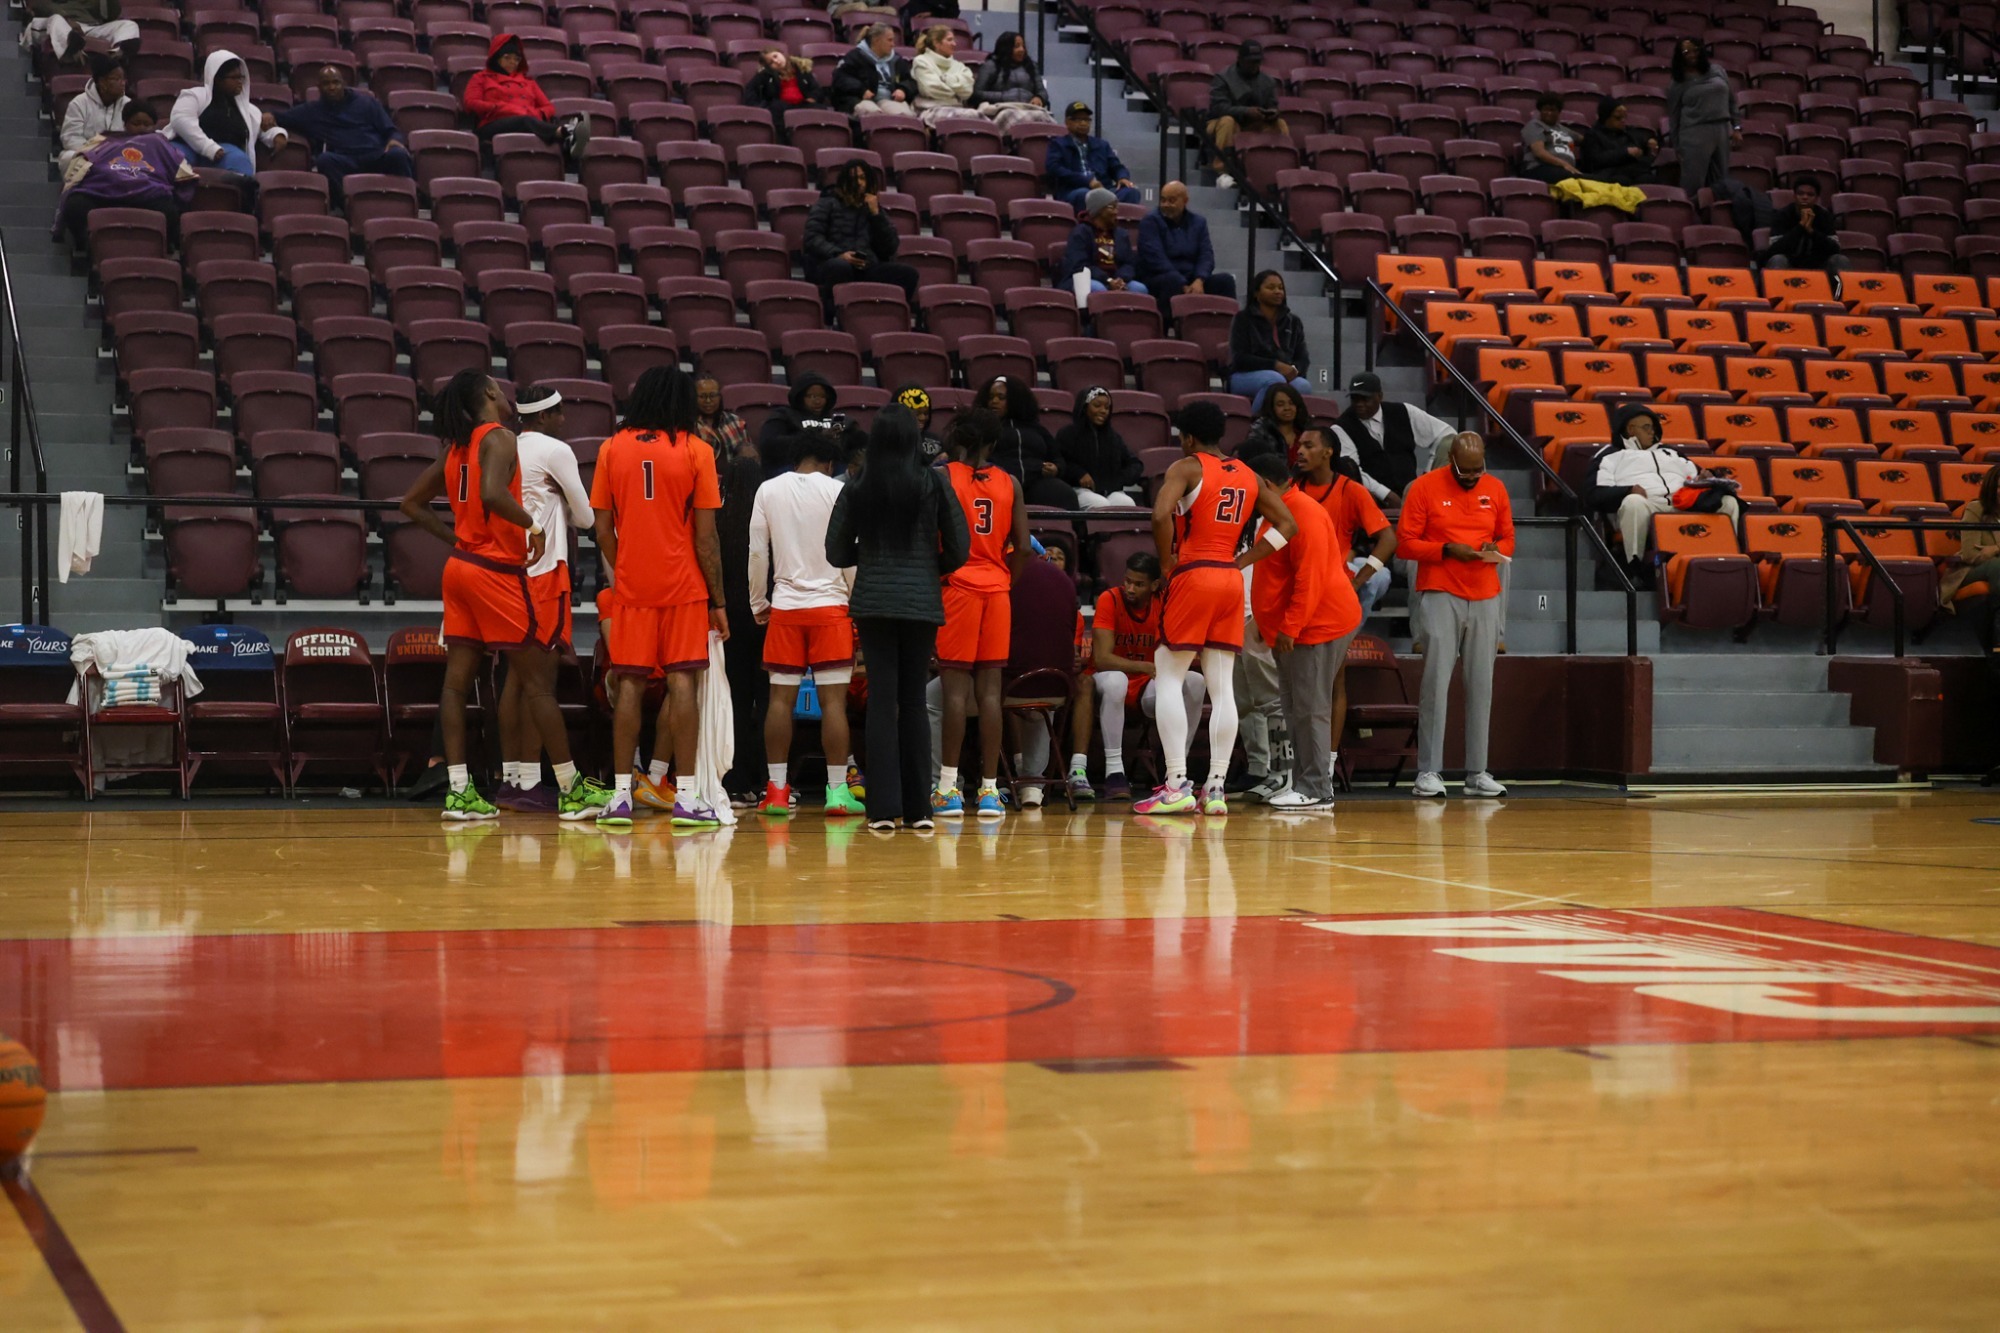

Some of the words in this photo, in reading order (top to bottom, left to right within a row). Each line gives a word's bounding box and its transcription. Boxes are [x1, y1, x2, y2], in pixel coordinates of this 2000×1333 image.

[458, 464, 469, 502] 1
[641, 460, 654, 500] 1
[1215, 487, 1246, 524] 21
[973, 498, 994, 535] 3
[1540, 596, 1546, 610] A
[0, 640, 14, 649] KE
[27, 636, 68, 654] YOURS
[230, 638, 271, 657] YOURS
[295, 633, 358, 649] OFFICIAL
[302, 646, 351, 657] SCORER
